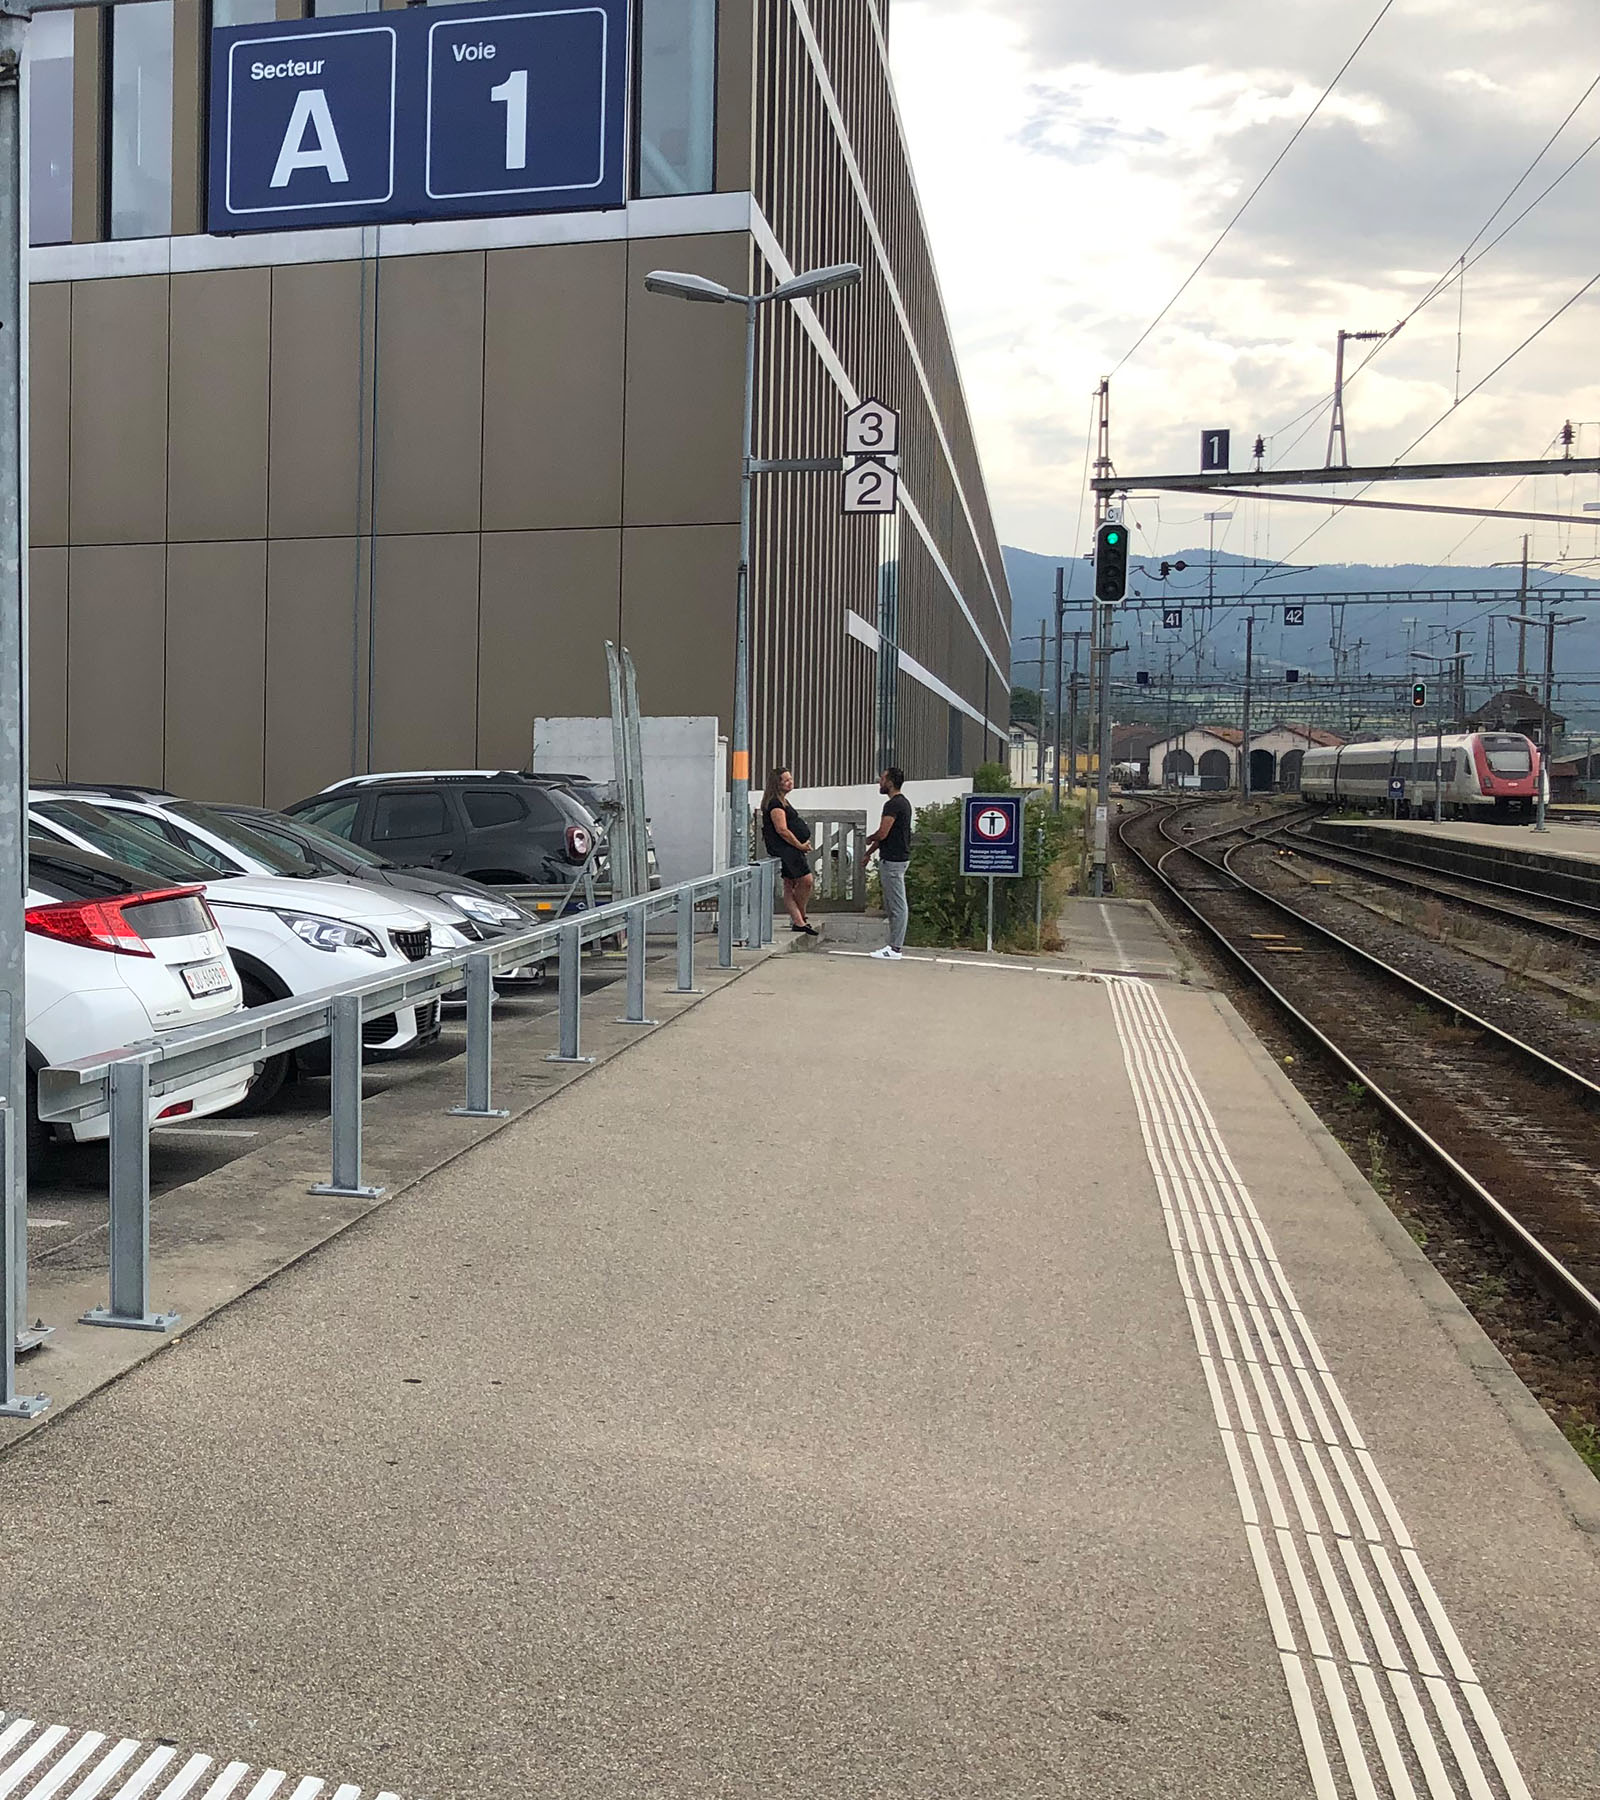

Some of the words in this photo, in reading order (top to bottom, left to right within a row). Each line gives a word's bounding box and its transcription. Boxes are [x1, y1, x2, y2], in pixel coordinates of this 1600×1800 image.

[452, 41, 496, 63] Voie
[251, 59, 325, 80] Secteur
[490, 70, 528, 170] 1
[269, 88, 349, 189] A
[859, 412, 883, 446] 3
[1209, 436, 1219, 464] 1
[856, 471, 882, 505] 2
[1165, 612, 1179, 626] 41
[1285, 609, 1302, 623] 42
